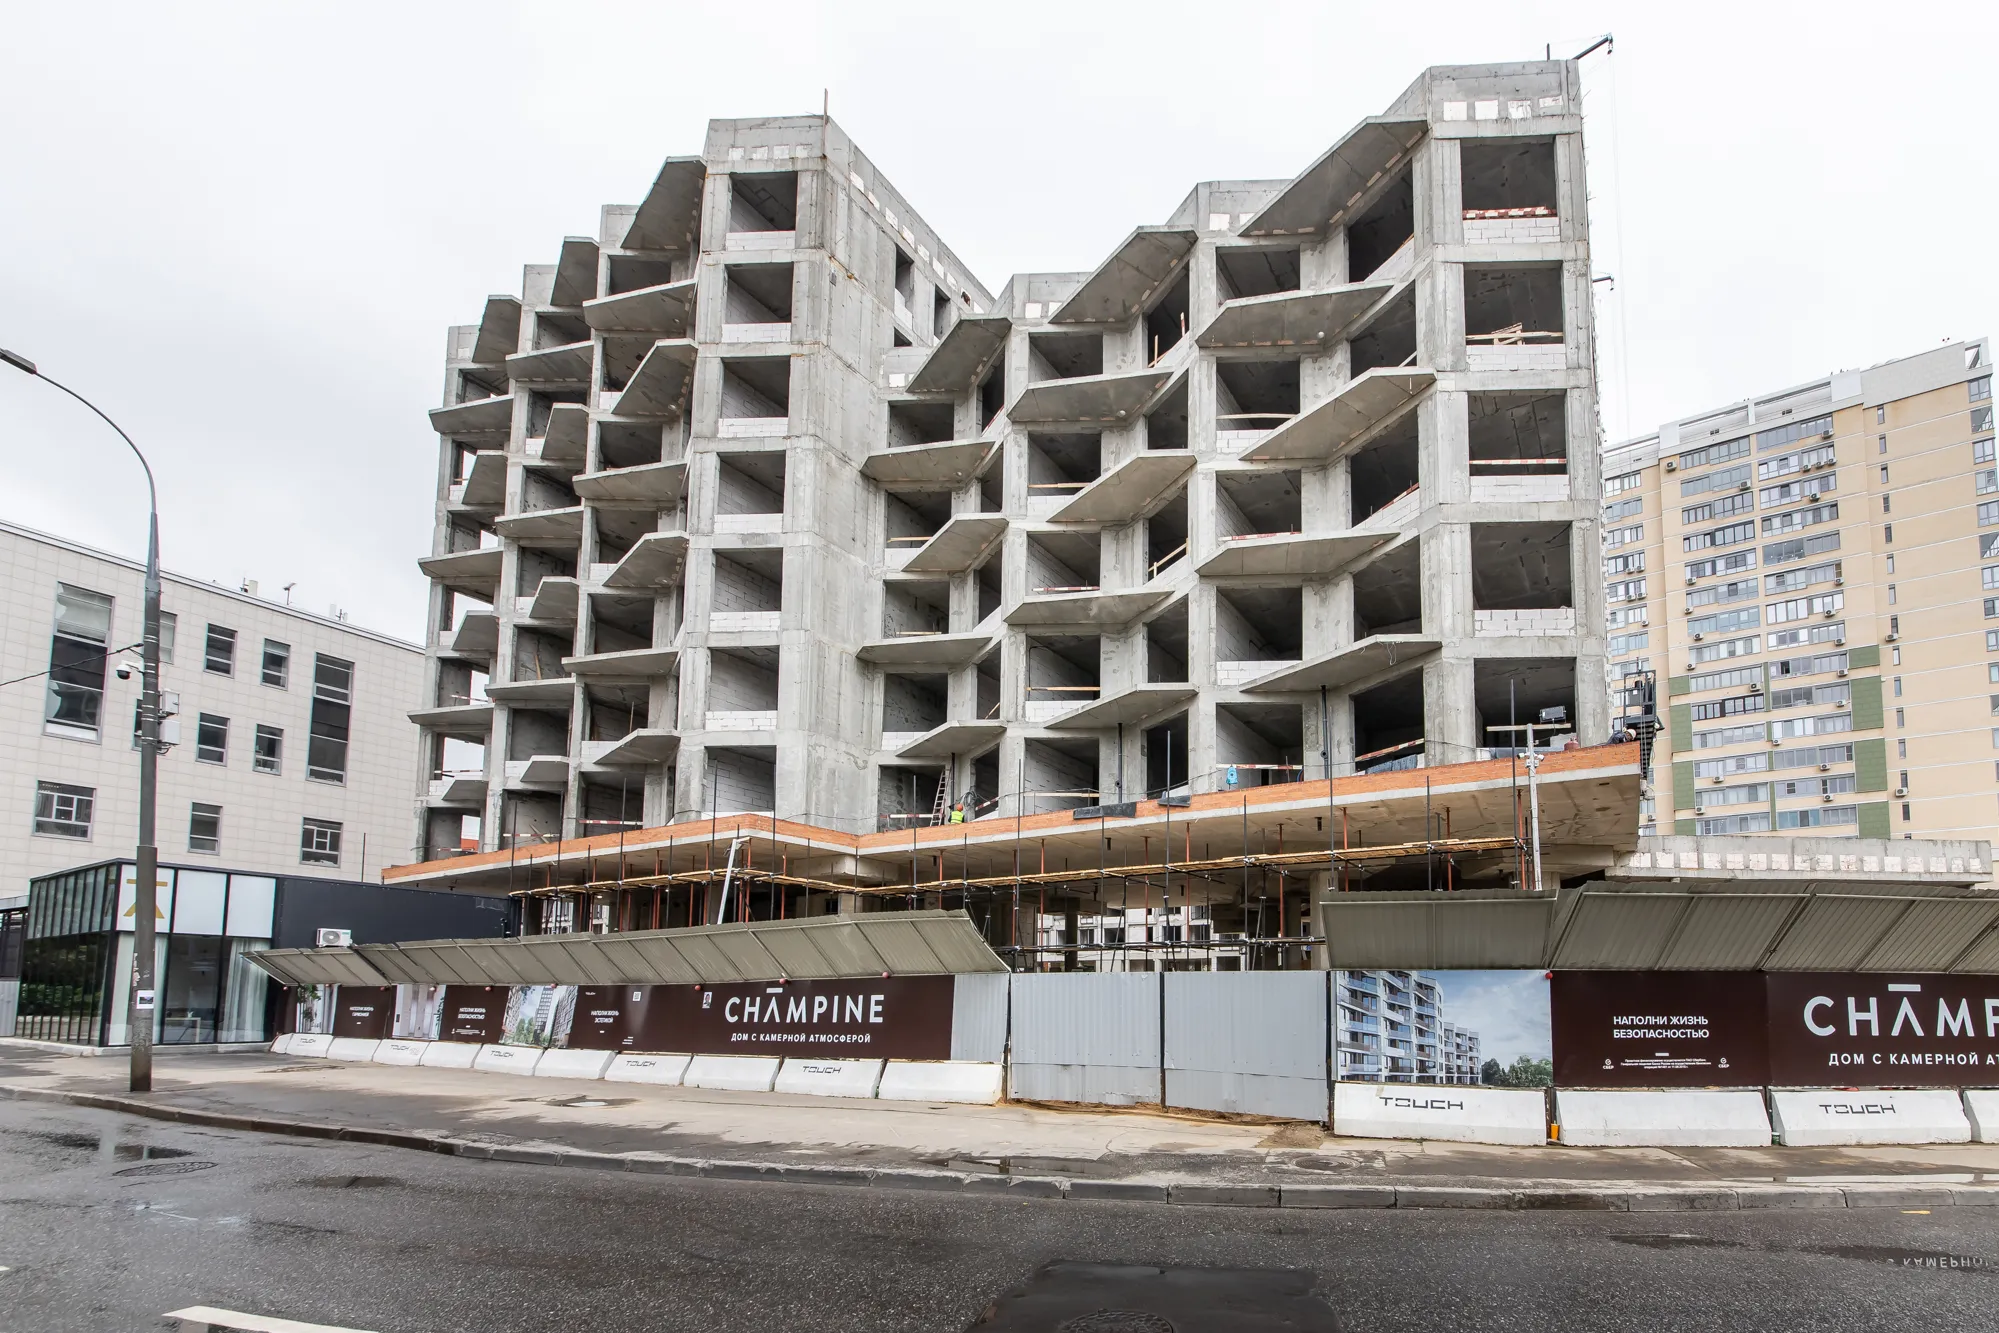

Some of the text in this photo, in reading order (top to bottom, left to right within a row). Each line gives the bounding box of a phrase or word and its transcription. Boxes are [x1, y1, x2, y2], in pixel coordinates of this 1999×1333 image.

[1613, 1016, 1709, 1025] НАПОЛНИ ЖИЗНЬ
[731, 1032, 871, 1044] ДОМ С КАМЕРНОЙ АТМОСФЕРОЙ
[1613, 1029, 1710, 1039] БЕЗОПАСНОСТЬЮ
[1829, 1053, 1865, 1066] ДОМ
[1872, 1053, 1882, 1065] С
[1889, 1052, 1979, 1065] КАМЕРНОЙ
[802, 1065, 842, 1074] TOUCH
[1379, 1096, 1463, 1110] TOUCH
[1819, 1104, 1896, 1114] TOUCH
